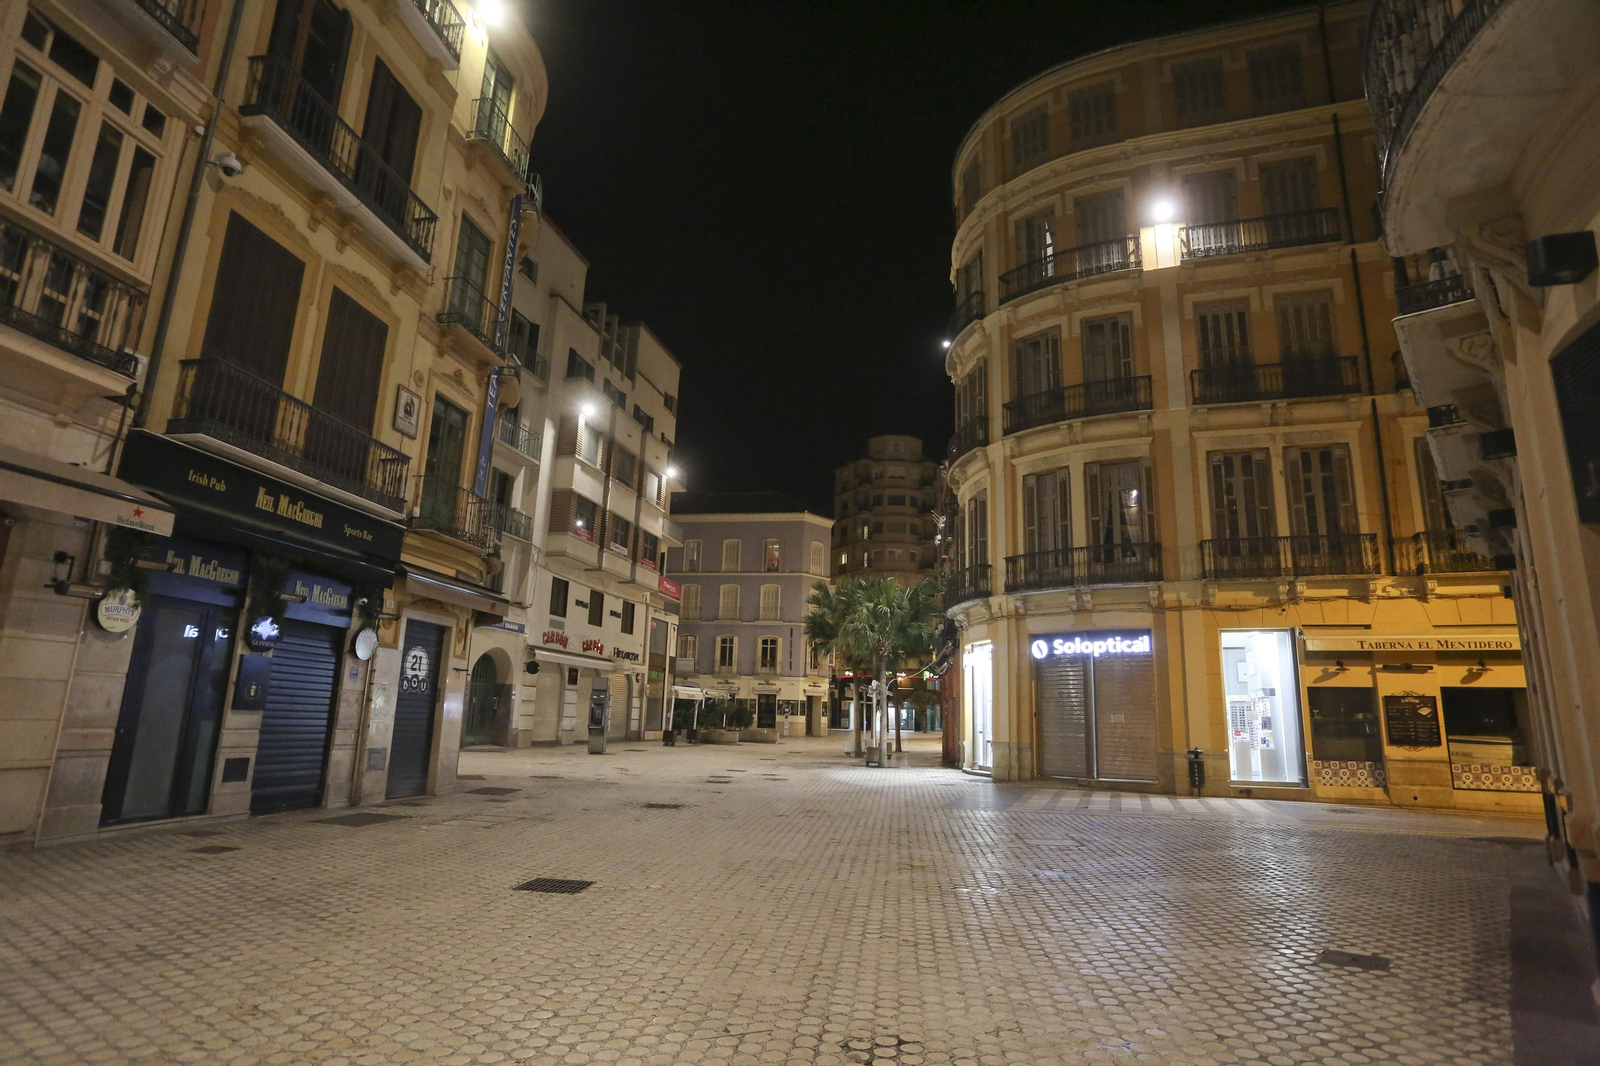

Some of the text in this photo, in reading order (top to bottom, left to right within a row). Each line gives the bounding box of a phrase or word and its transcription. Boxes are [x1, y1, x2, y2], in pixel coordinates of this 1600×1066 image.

[187, 470, 226, 492] Irish Pub
[116, 515, 155, 531] Heineken
[343, 523, 373, 541] Sports Bar
[504, 623, 518, 631] DIANA
[1052, 635, 1150, 657] Soloptical
[1356, 639, 1513, 650] TABERNA EL MENTIDERO
[410, 655, 423, 672] 21
[402, 677, 427, 691] BOU
